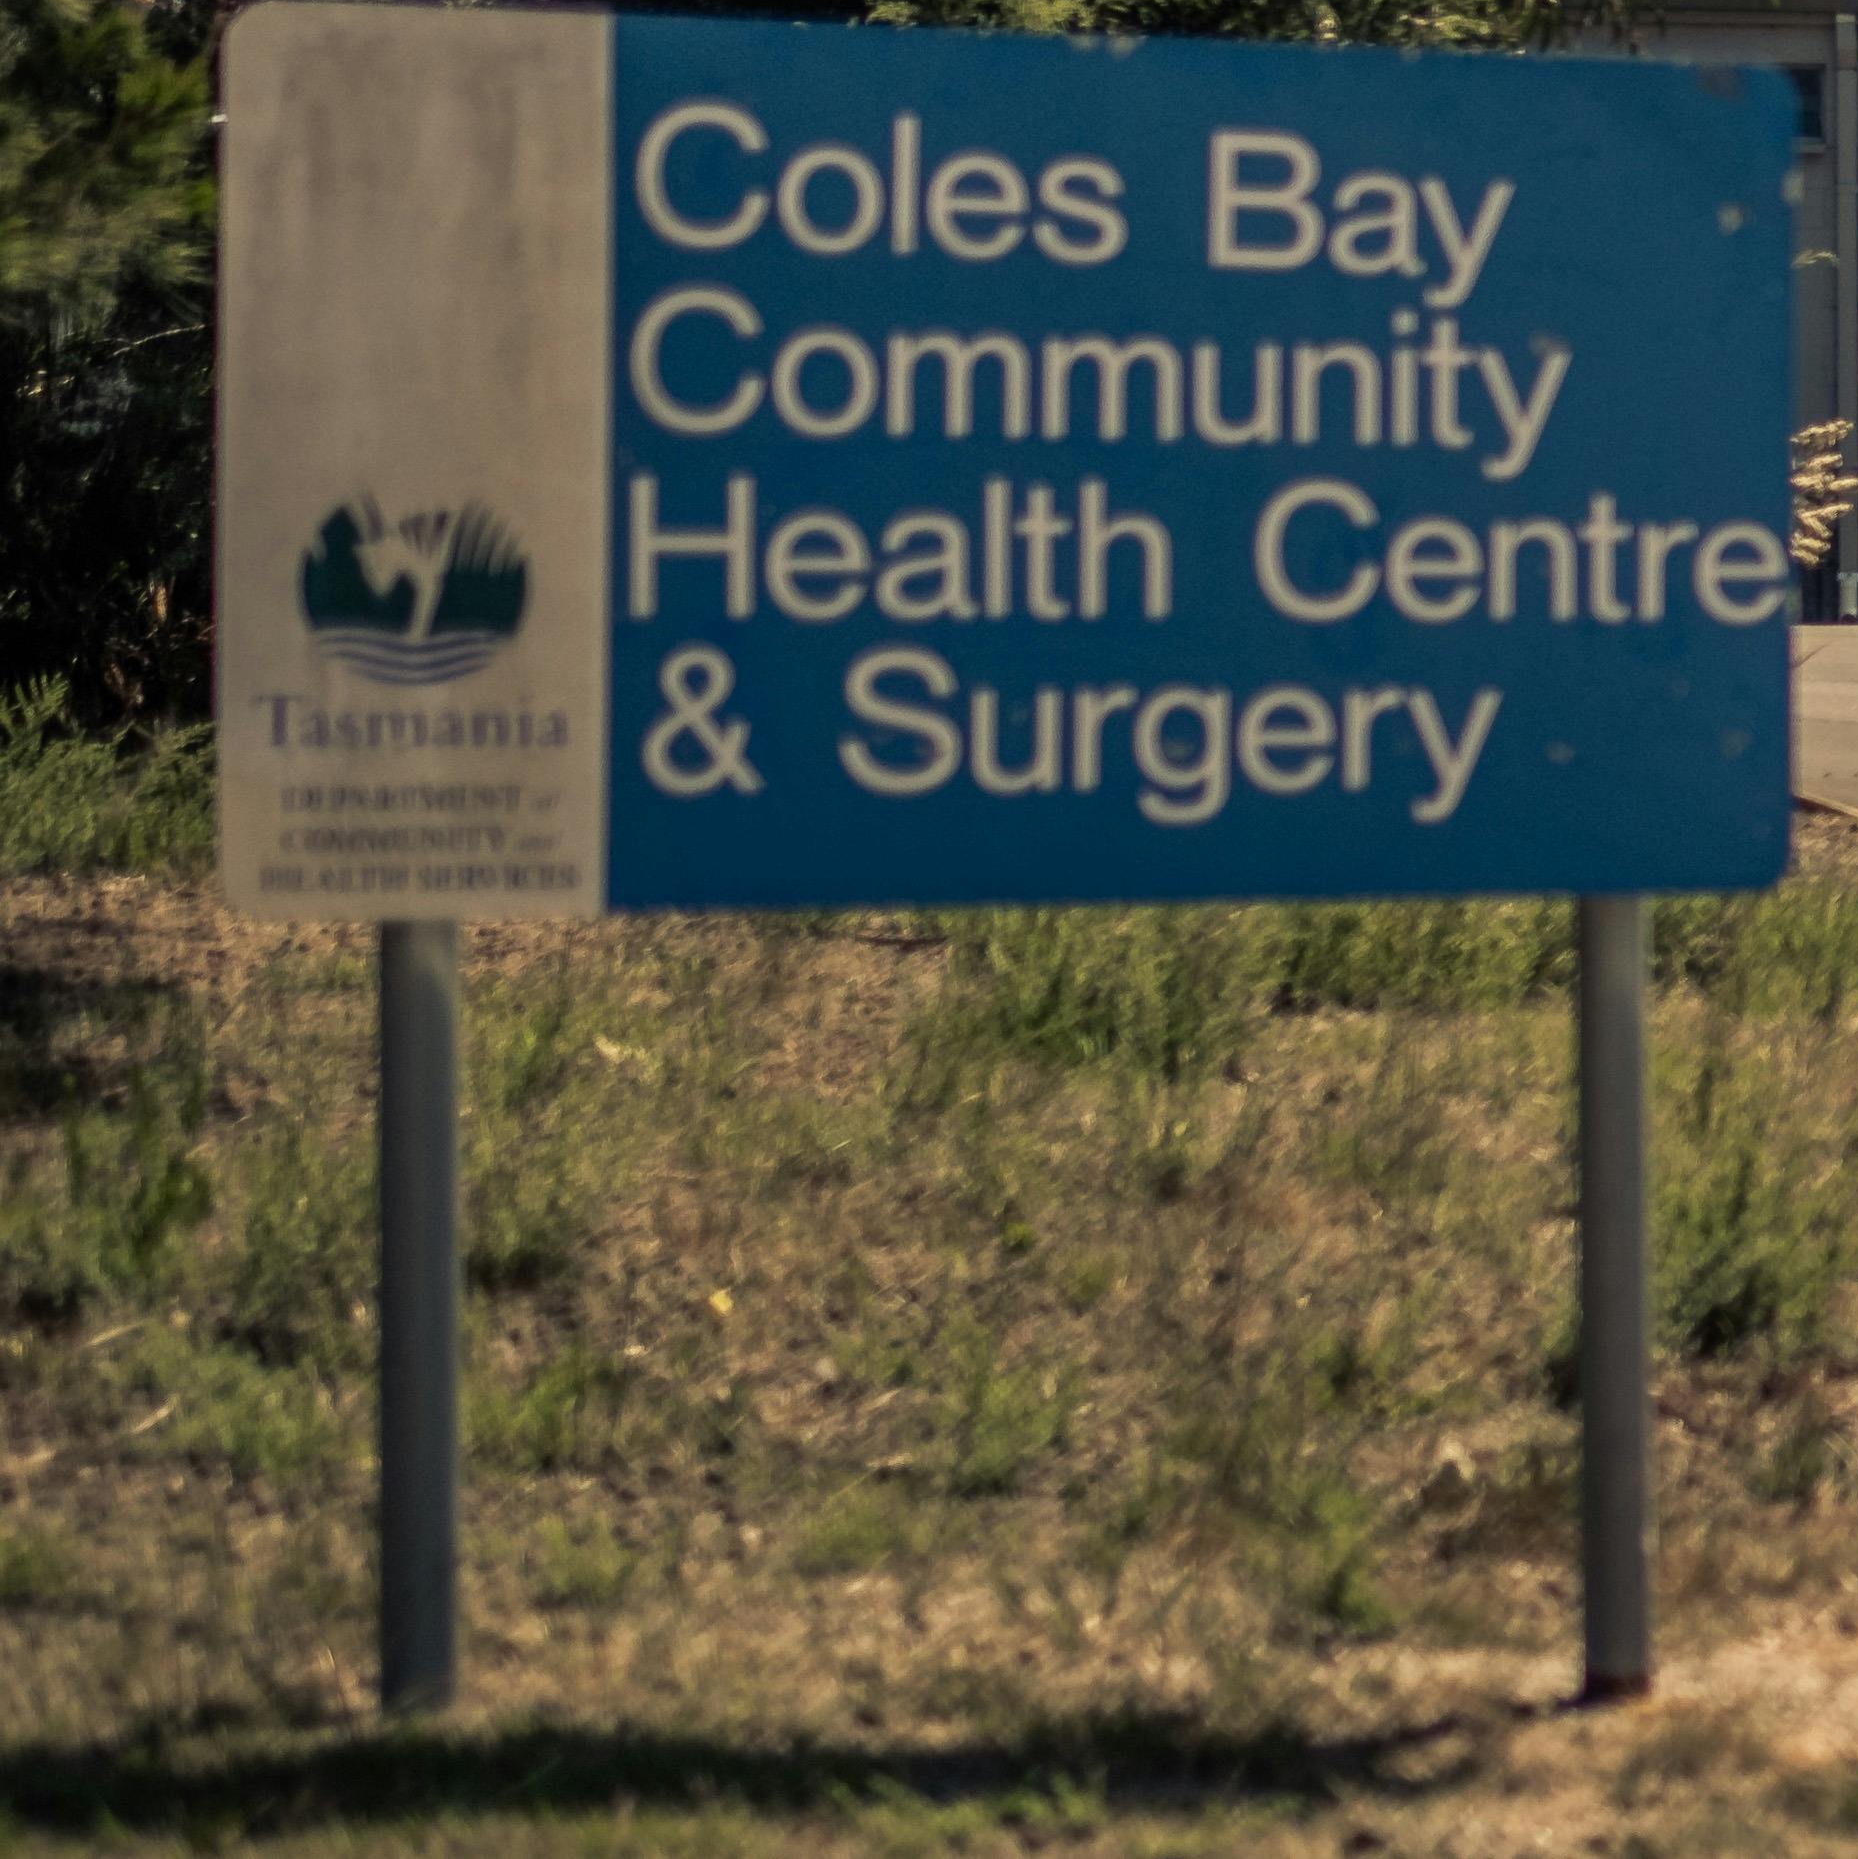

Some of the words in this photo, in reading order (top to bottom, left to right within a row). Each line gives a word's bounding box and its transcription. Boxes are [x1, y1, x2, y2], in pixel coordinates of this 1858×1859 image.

[634, 100, 1129, 266] Coles
[1206, 126, 1516, 312] Bay
[628, 285, 1573, 482] Community
[628, 474, 1173, 622] Health
[1253, 477, 1794, 627] Centre
[250, 693, 569, 748] Tasmania
[641, 646, 764, 797] &
[838, 646, 1502, 825] Surgery
[278, 826, 506, 853] COMMUNITY
[417, 863, 583, 893] SERVICES
